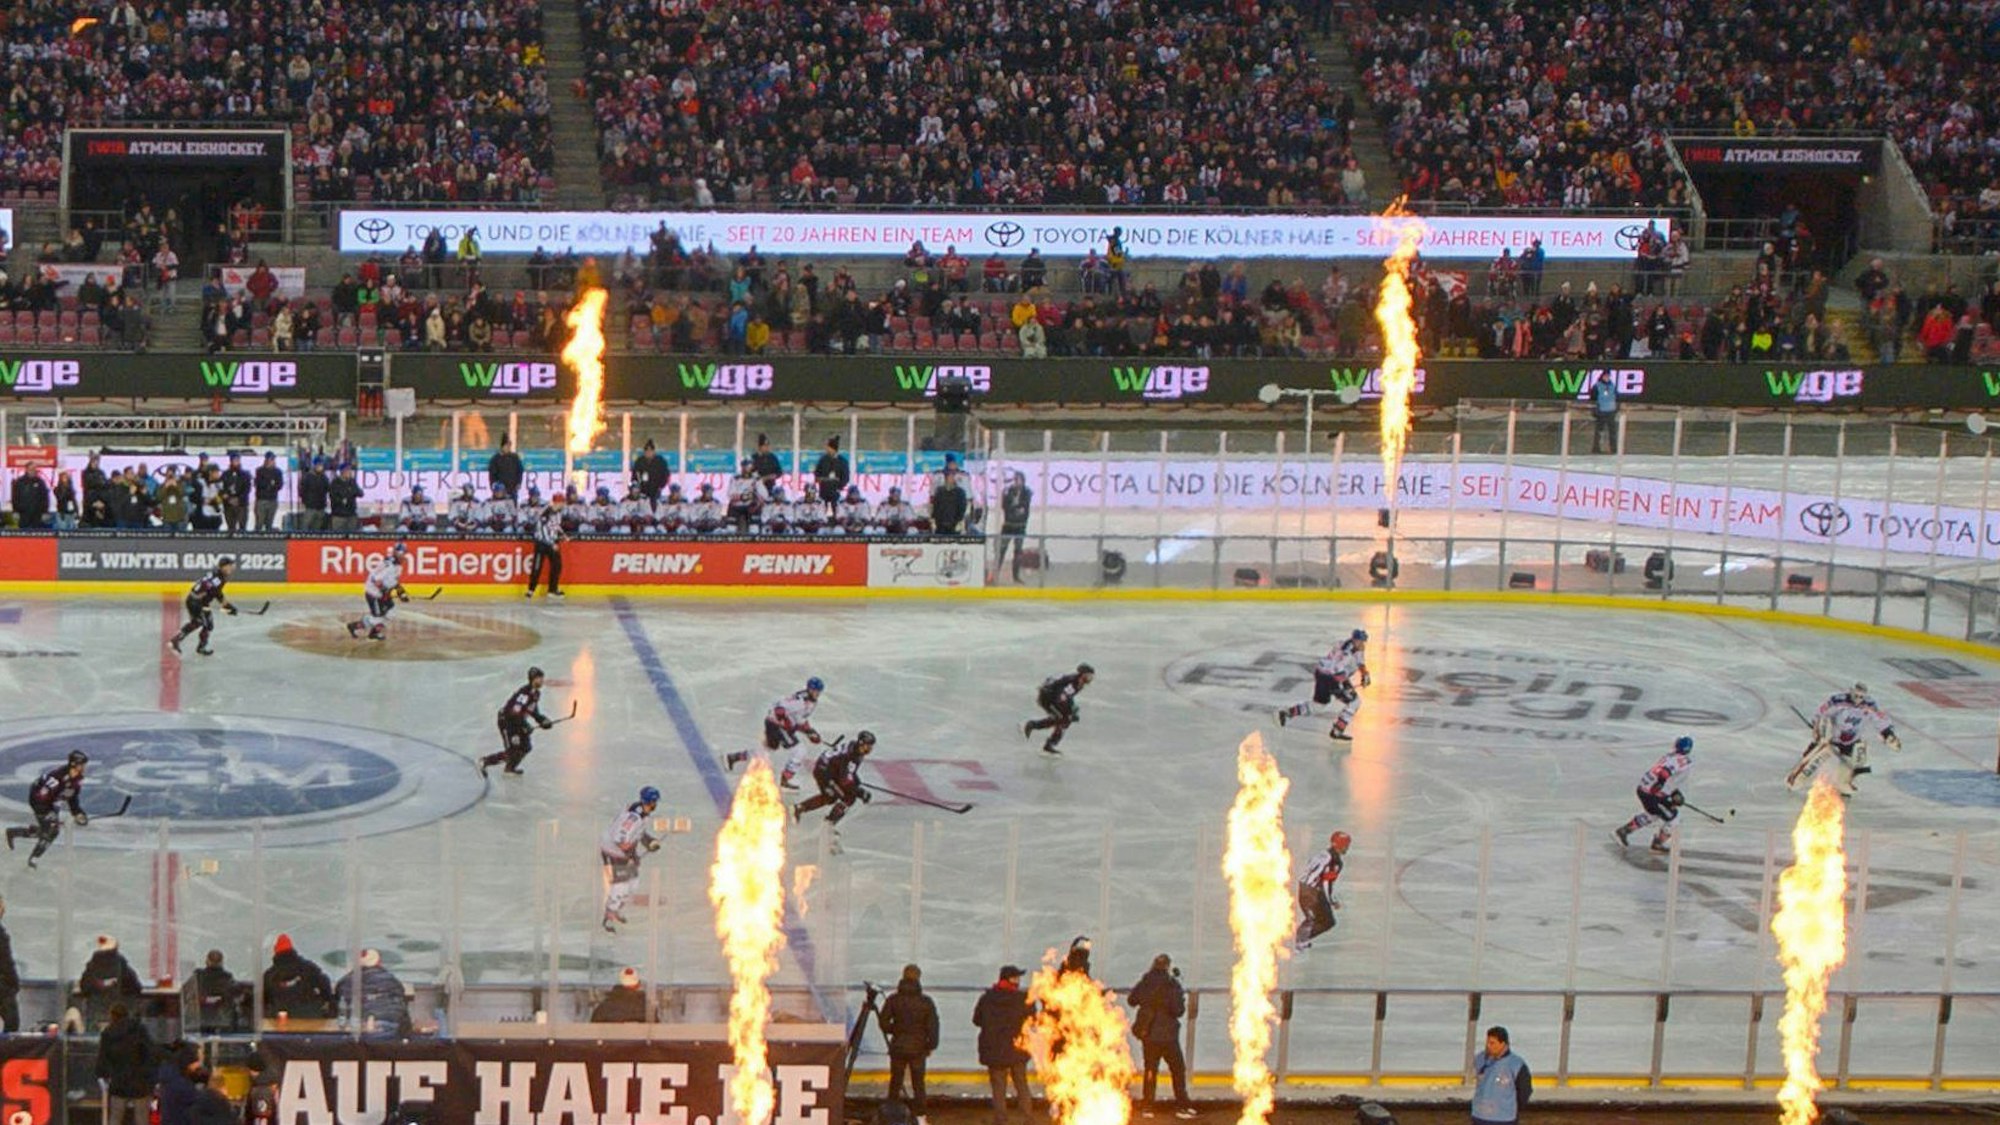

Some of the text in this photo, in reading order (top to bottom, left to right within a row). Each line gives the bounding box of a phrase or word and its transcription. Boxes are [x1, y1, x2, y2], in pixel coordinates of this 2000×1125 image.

[488, 224, 533, 241] UND
[538, 224, 571, 241] DIE
[726, 225, 767, 242] SEIT
[772, 226, 796, 243] 20
[800, 226, 877, 243] JAHREN
[883, 226, 915, 243] EIN
[921, 227, 973, 243] TEAM
[1033, 227, 1109, 244] TOYOTA
[1167, 228, 1199, 245] DIE
[1205, 224, 1283, 245] KÖLNER
[1288, 228, 1334, 245] HAIE
[1429, 230, 1505, 246] JAHREN
[1512, 231, 1544, 247] EIN
[1551, 231, 1602, 247] TEAM
[1262, 470, 1365, 496] KÖLNER
[1519, 479, 1547, 502] 20
[1551, 484, 1652, 514] JAHREN
[1660, 493, 1700, 518] EIN
[1710, 499, 1783, 526] TEAM
[1863, 512, 1975, 544] TOYOTA
[61, 552, 286, 570] DEL WINTER GAM 2022
[279, 1060, 448, 1125] AUF
